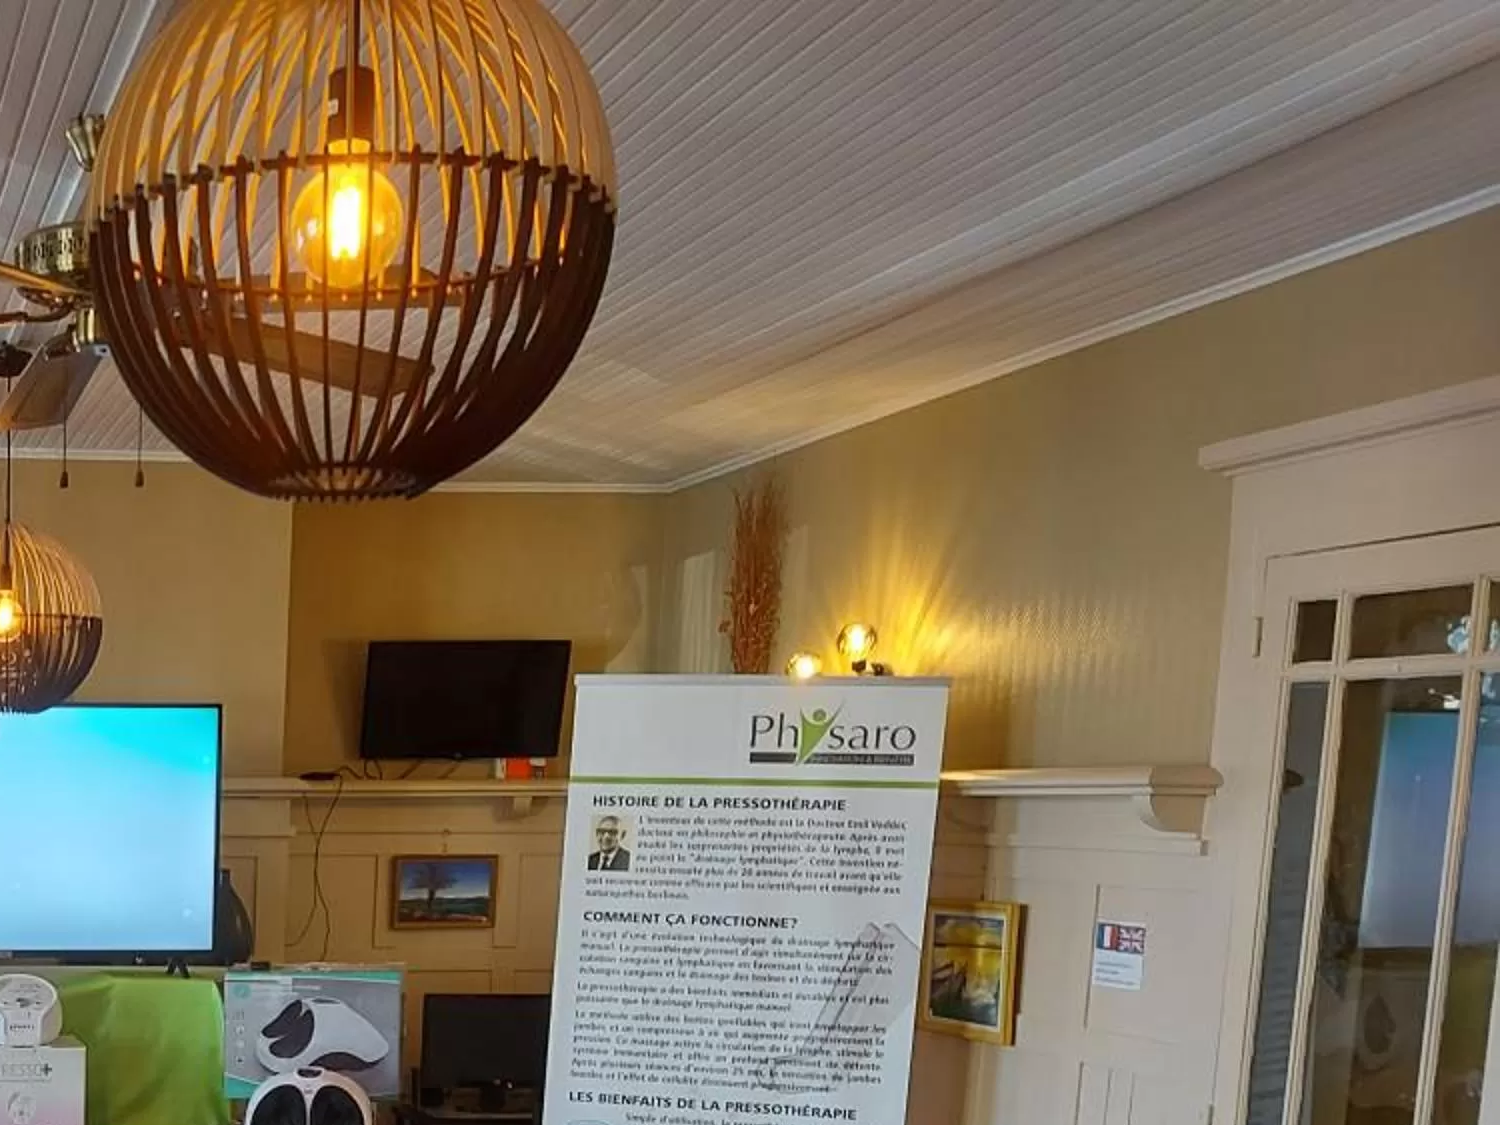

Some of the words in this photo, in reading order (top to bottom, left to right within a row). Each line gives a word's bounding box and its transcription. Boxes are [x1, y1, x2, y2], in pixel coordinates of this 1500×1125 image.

[750, 700, 917, 764] Physaro
[593, 795, 658, 808] HISTOIRE
[664, 796, 685, 808] DE
[689, 798, 708, 808] LA
[713, 797, 846, 811] PRESSOTHÉRAPIE
[583, 911, 660, 924] COMMENT
[665, 913, 686, 926] ÇA
[691, 914, 798, 928] FONCTIONNE?
[569, 1091, 593, 1103] LES
[598, 1093, 672, 1108] BIENFAITS
[677, 1098, 696, 1109] DE
[701, 1100, 721, 1111] LA
[726, 1101, 857, 1120] PRESSOTHÉRAPIE
